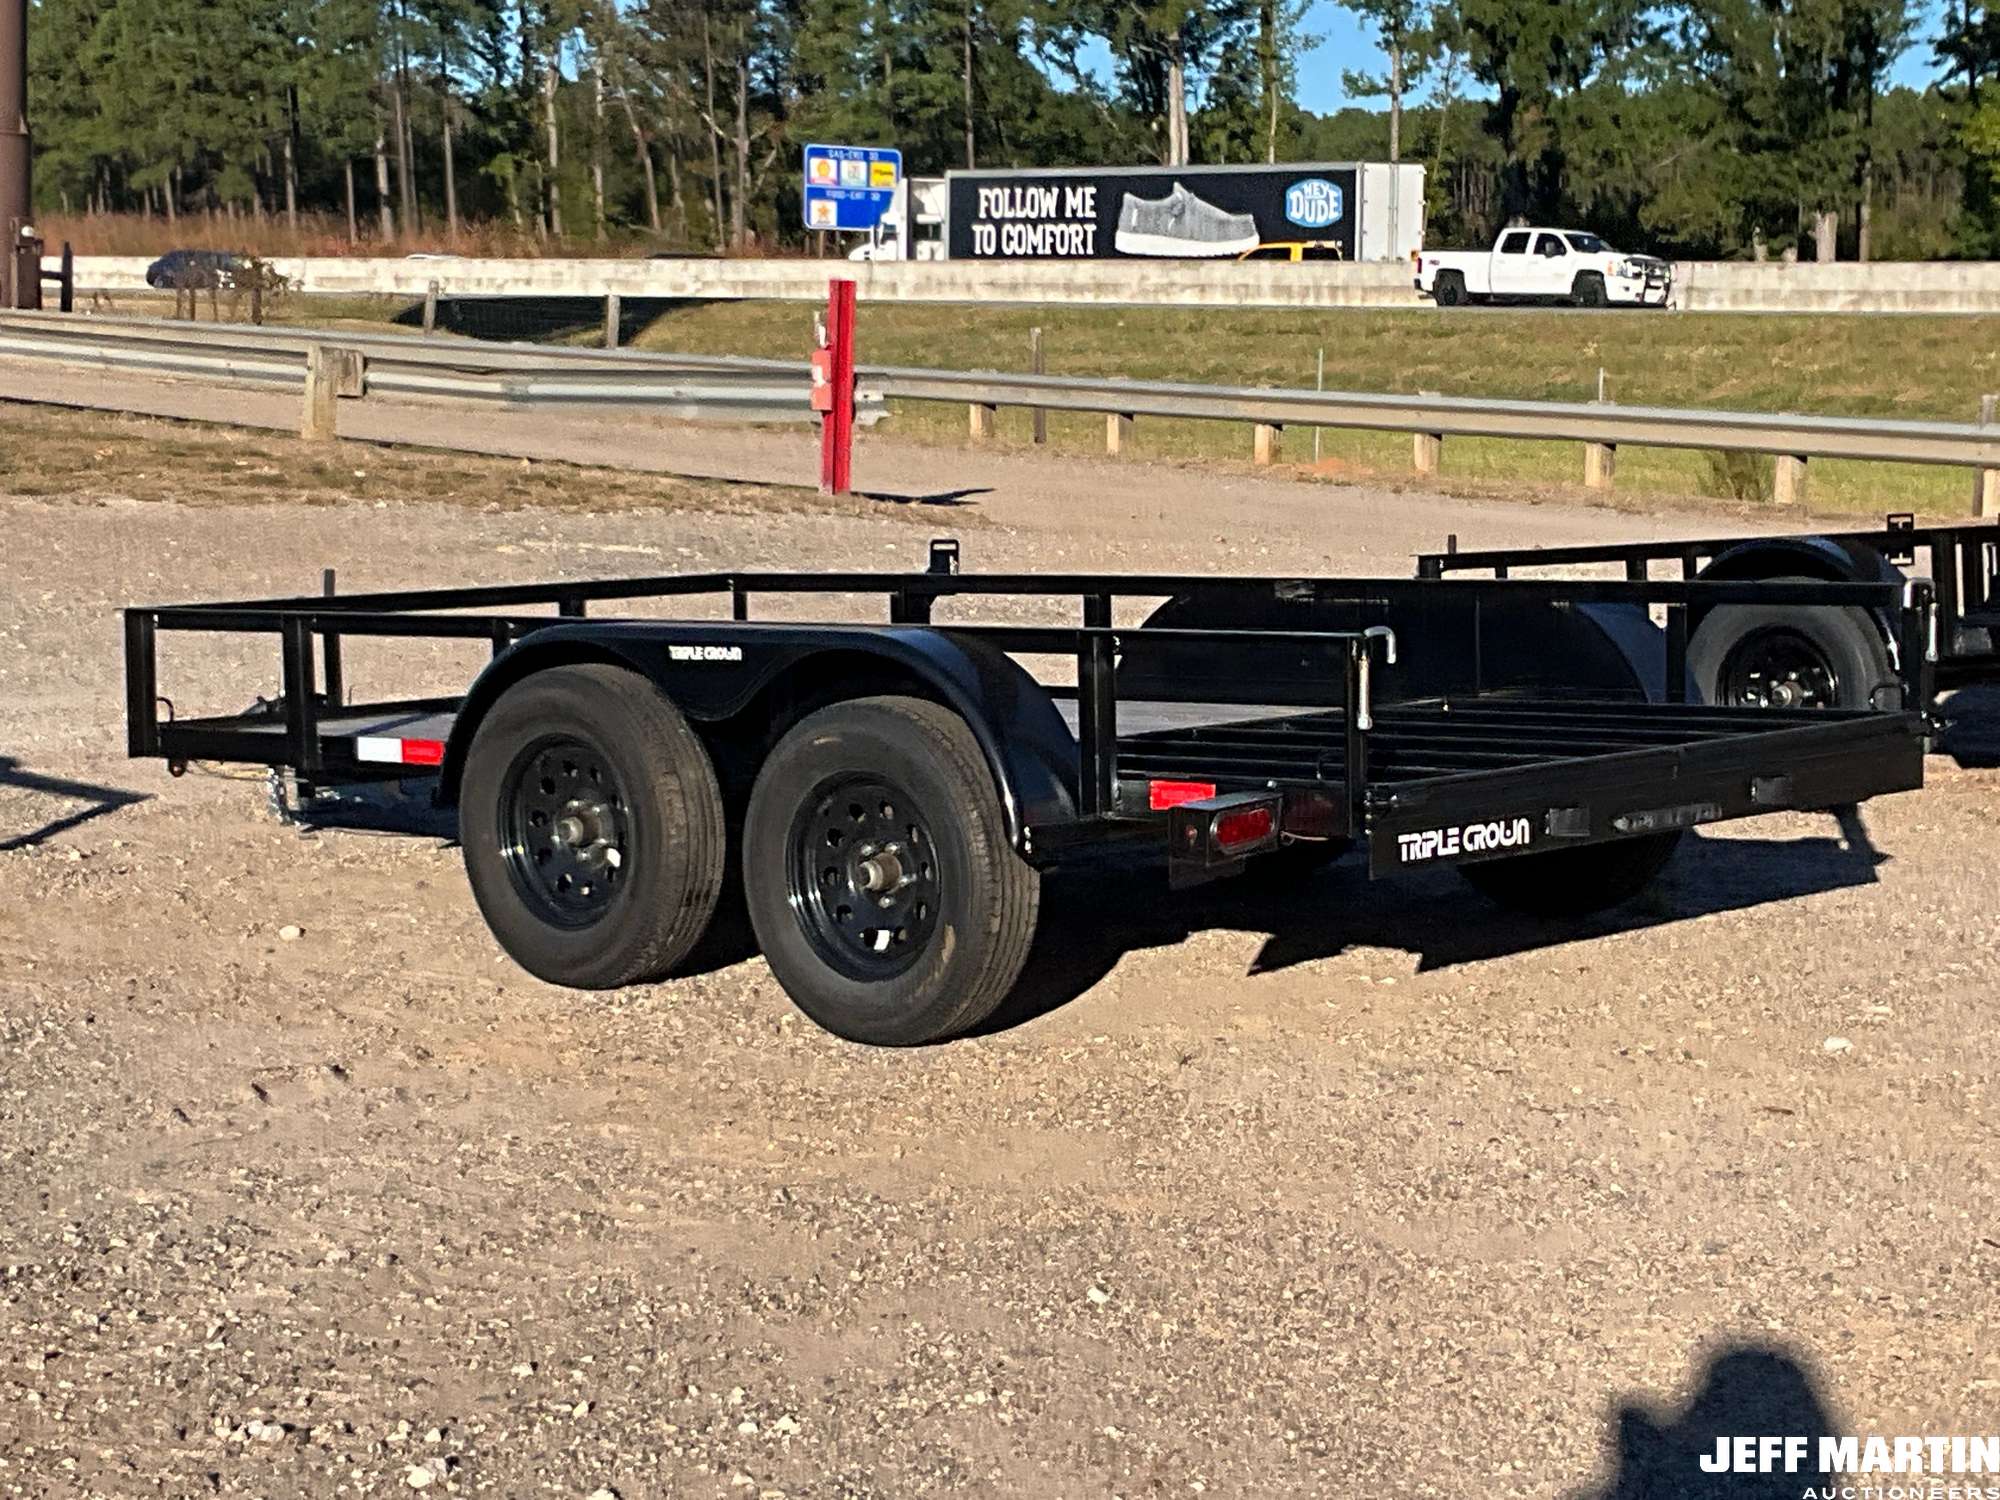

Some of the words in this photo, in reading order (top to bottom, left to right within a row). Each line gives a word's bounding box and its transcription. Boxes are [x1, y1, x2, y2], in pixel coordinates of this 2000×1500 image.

[978, 186, 1060, 219] FOLLOW
[1064, 186, 1098, 219] ME
[1289, 190, 1339, 224] DUDE
[1302, 182, 1330, 199] HEY
[971, 223, 997, 256] TO
[1001, 223, 1098, 256] COMFORT
[668, 645, 704, 660] TRIPLE
[704, 646, 743, 661] CROWN
[1398, 828, 1460, 862] TRIPLE
[1462, 818, 1530, 852] CROWN
